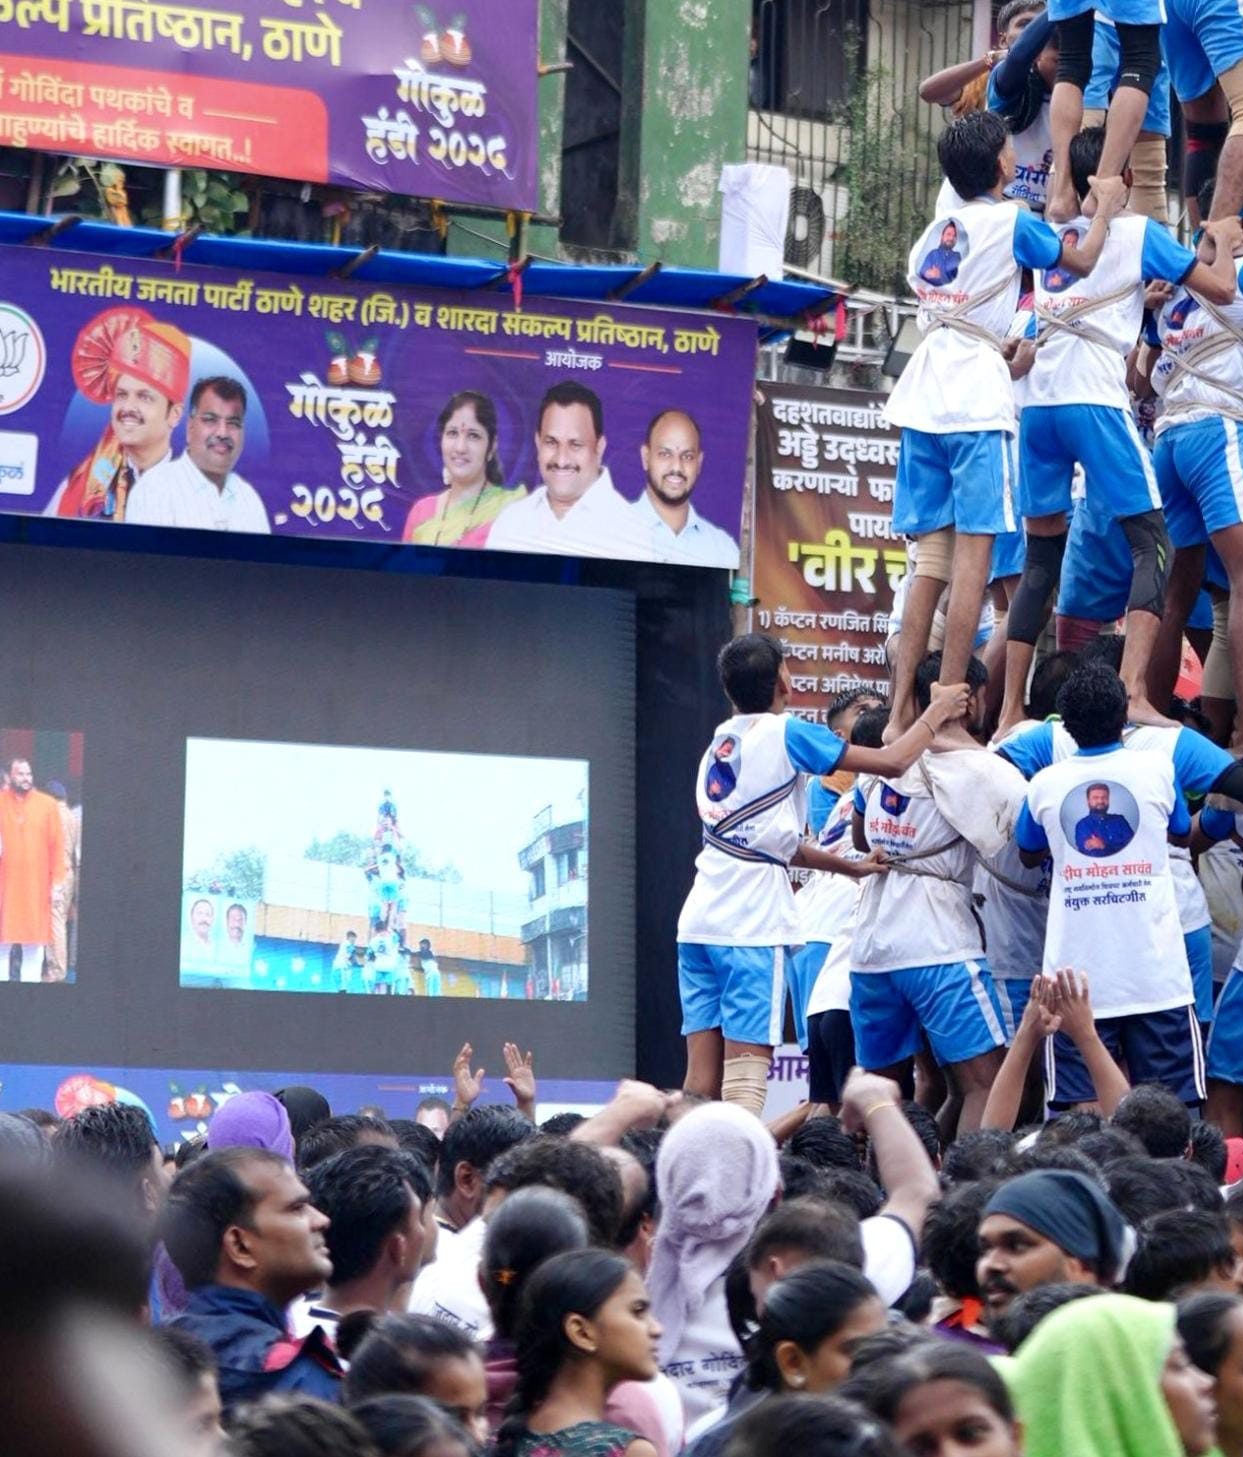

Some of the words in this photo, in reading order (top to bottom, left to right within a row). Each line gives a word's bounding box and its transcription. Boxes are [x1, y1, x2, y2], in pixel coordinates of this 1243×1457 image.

[259, 11, 342, 67] ठाणे
[9, 71, 84, 110] गोविंदा
[90, 84, 173, 117] पथकांचे
[177, 96, 195, 120] व
[92, 119, 161, 152] हार्दिक
[50, 264, 133, 299] भारतीय
[138, 277, 199, 306] जनता
[203, 279, 251, 312] पार्टी
[255, 286, 303, 316] ठाणे
[308, 294, 358, 322] शहर
[414, 306, 432, 327] व
[437, 304, 498, 335] शारदा
[501, 309, 572, 341] संकल्प
[576, 314, 669, 353] प्रतिष्ठान,
[673, 325, 721, 356] ठाणे
[545, 349, 604, 372] आयोजक
[774, 607, 816, 629] कॅप्टन
[819, 611, 869, 632] रणजित
[822, 642, 859, 663] मनीष
[1086, 862, 1119, 878] मोहन
